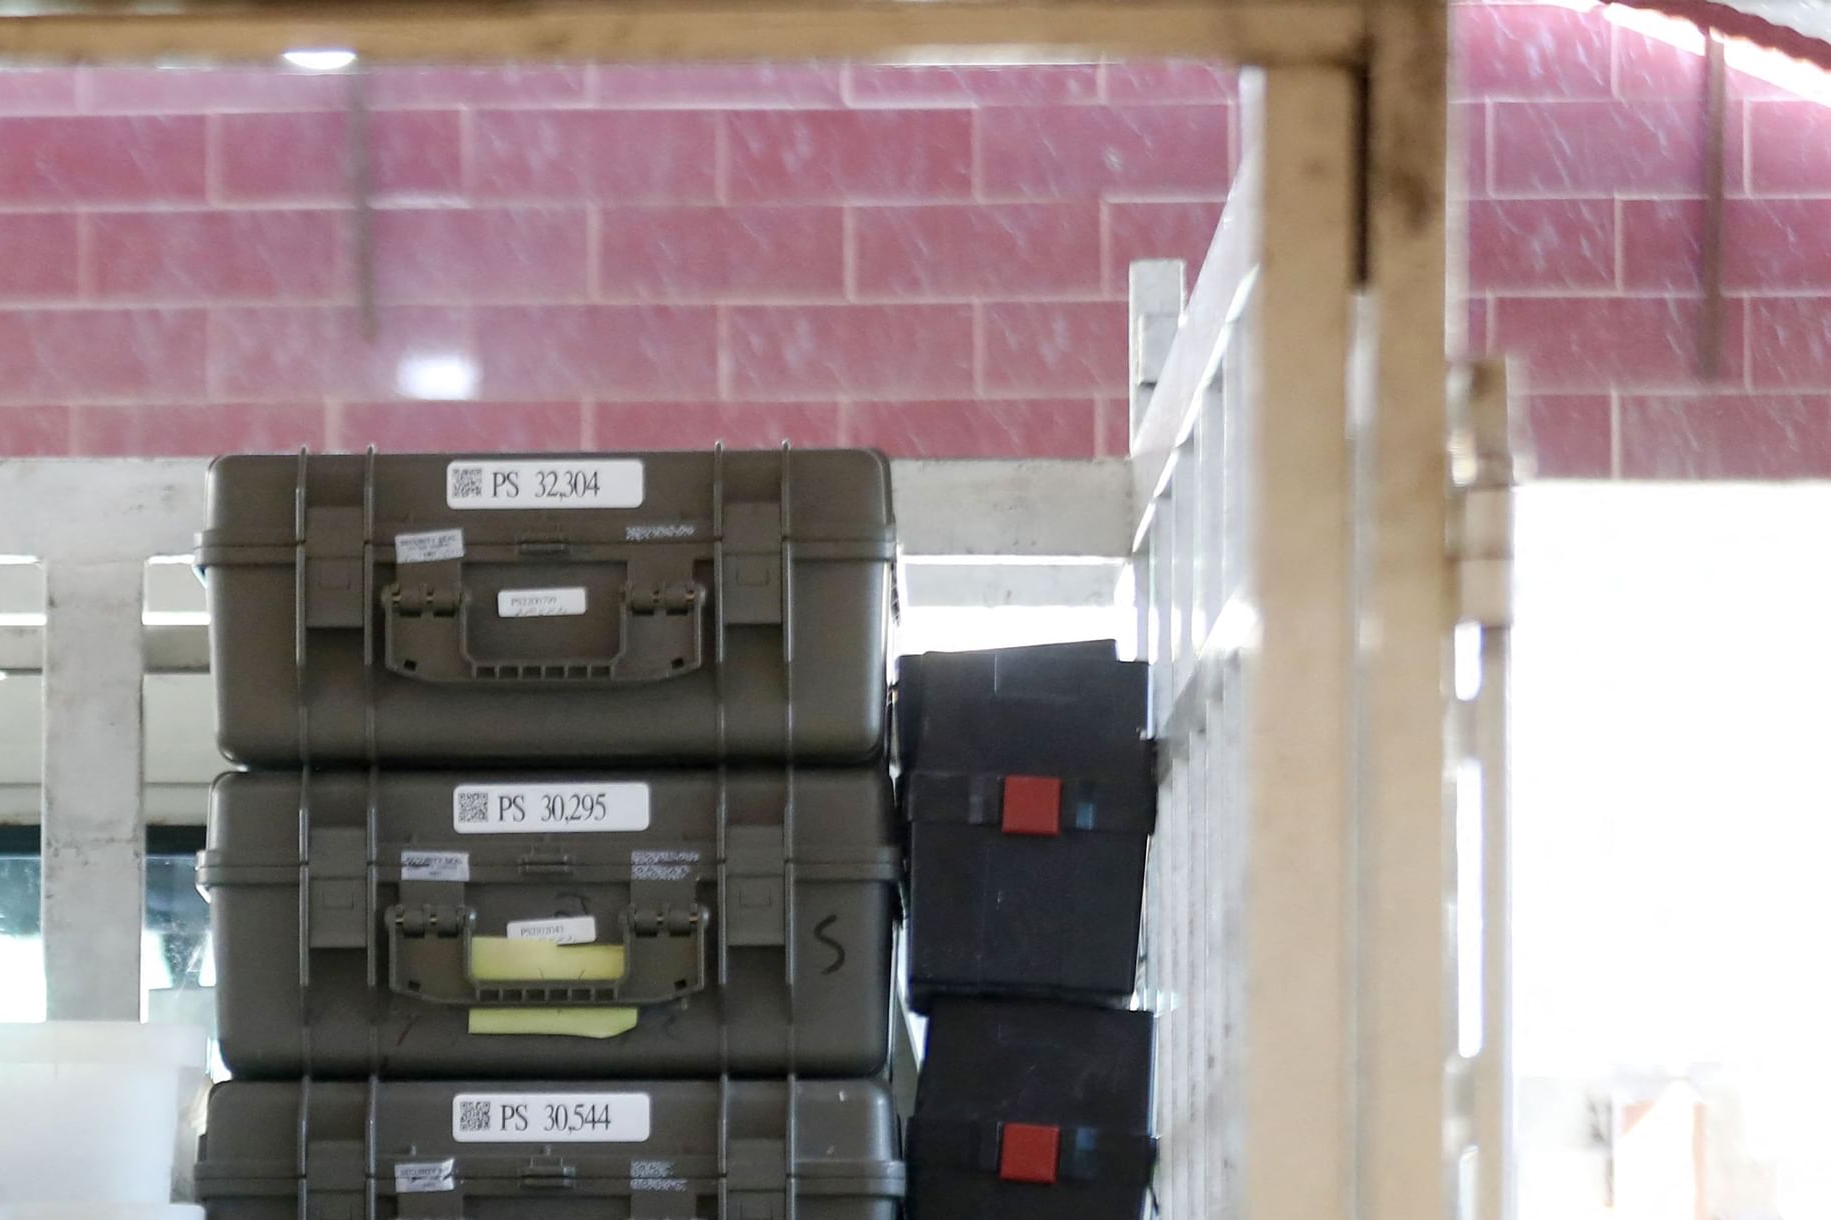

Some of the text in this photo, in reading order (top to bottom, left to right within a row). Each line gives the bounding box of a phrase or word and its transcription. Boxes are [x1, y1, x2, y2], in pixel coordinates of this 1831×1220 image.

[491, 470, 601, 502] PS 32,304
[497, 793, 607, 825] PS 30,295
[499, 1103, 612, 1135] PS 30,544
